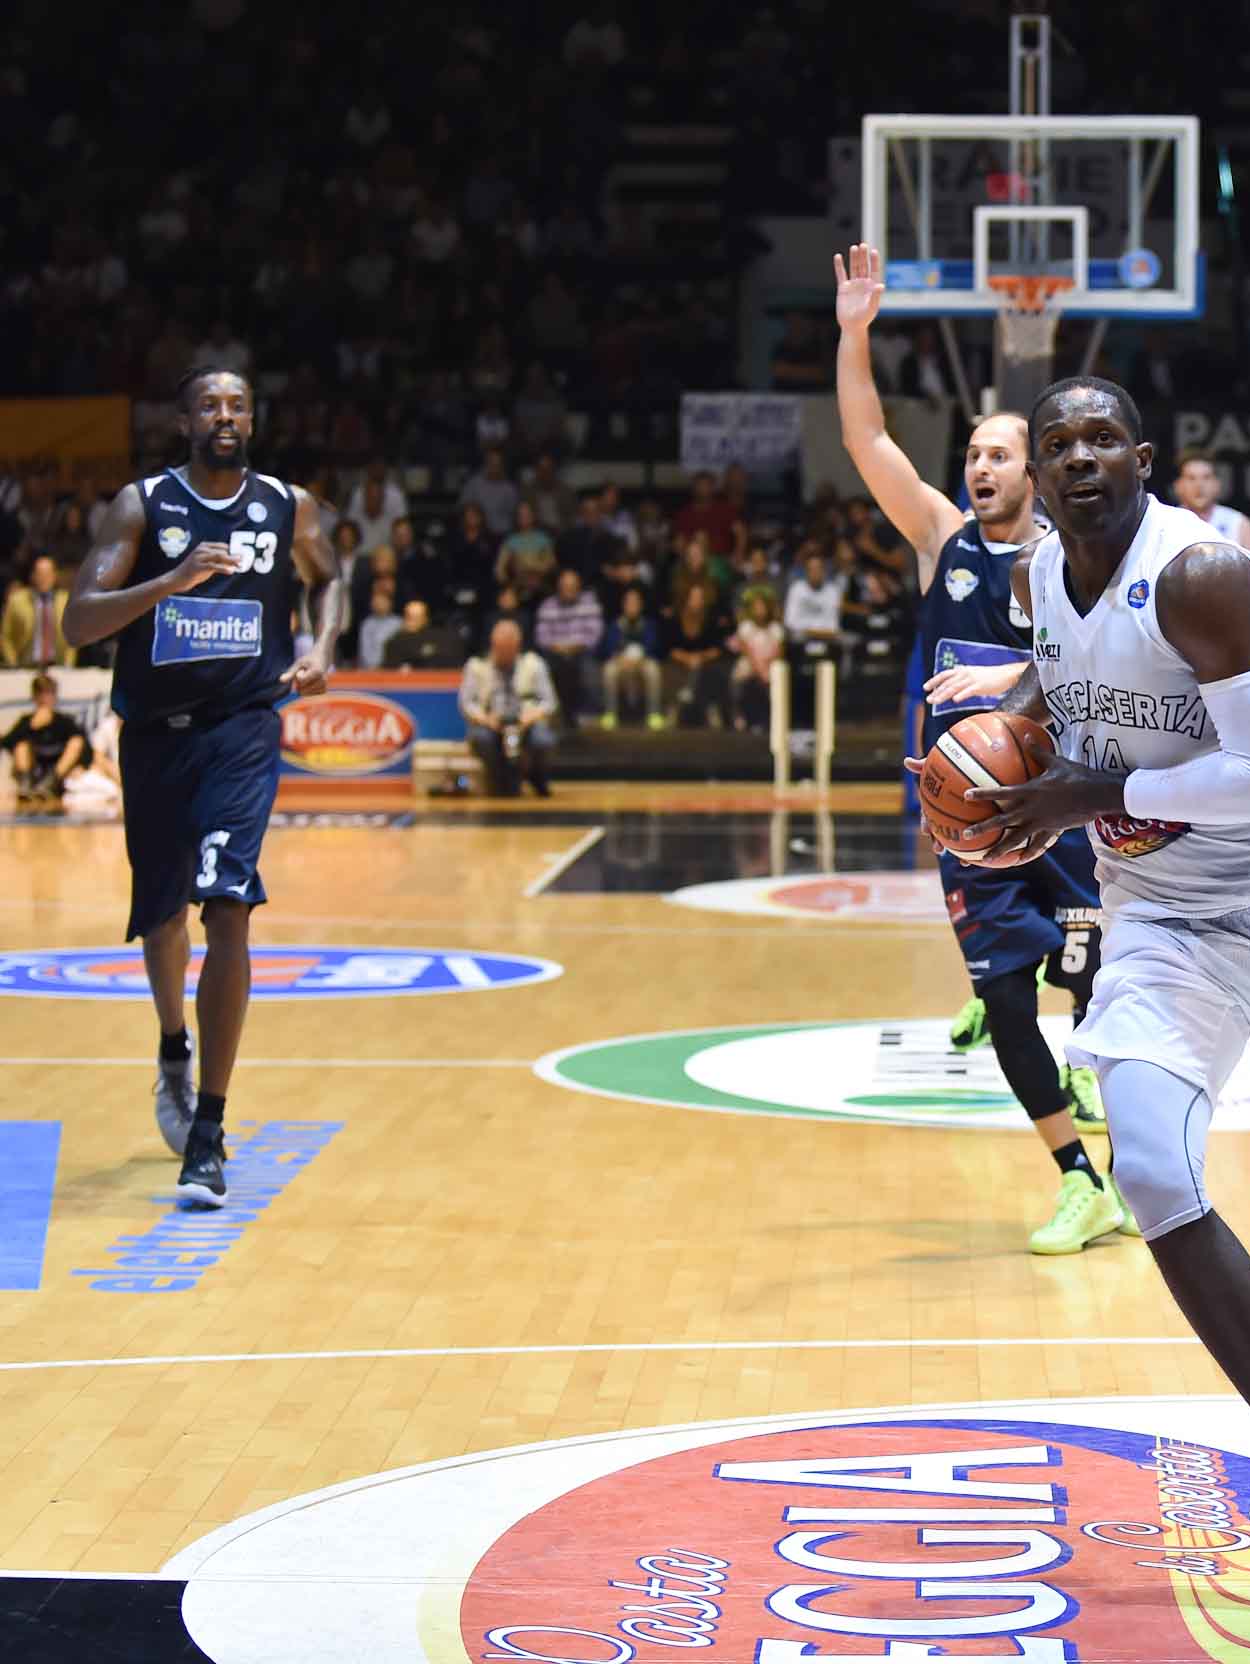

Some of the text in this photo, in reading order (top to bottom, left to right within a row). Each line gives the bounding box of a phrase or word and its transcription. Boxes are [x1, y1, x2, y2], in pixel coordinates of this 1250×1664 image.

[229, 531, 278, 574] 53
[176, 615, 259, 641] manital
[1061, 930, 1090, 974] 5
[481, 1547, 730, 1664] Pasta
